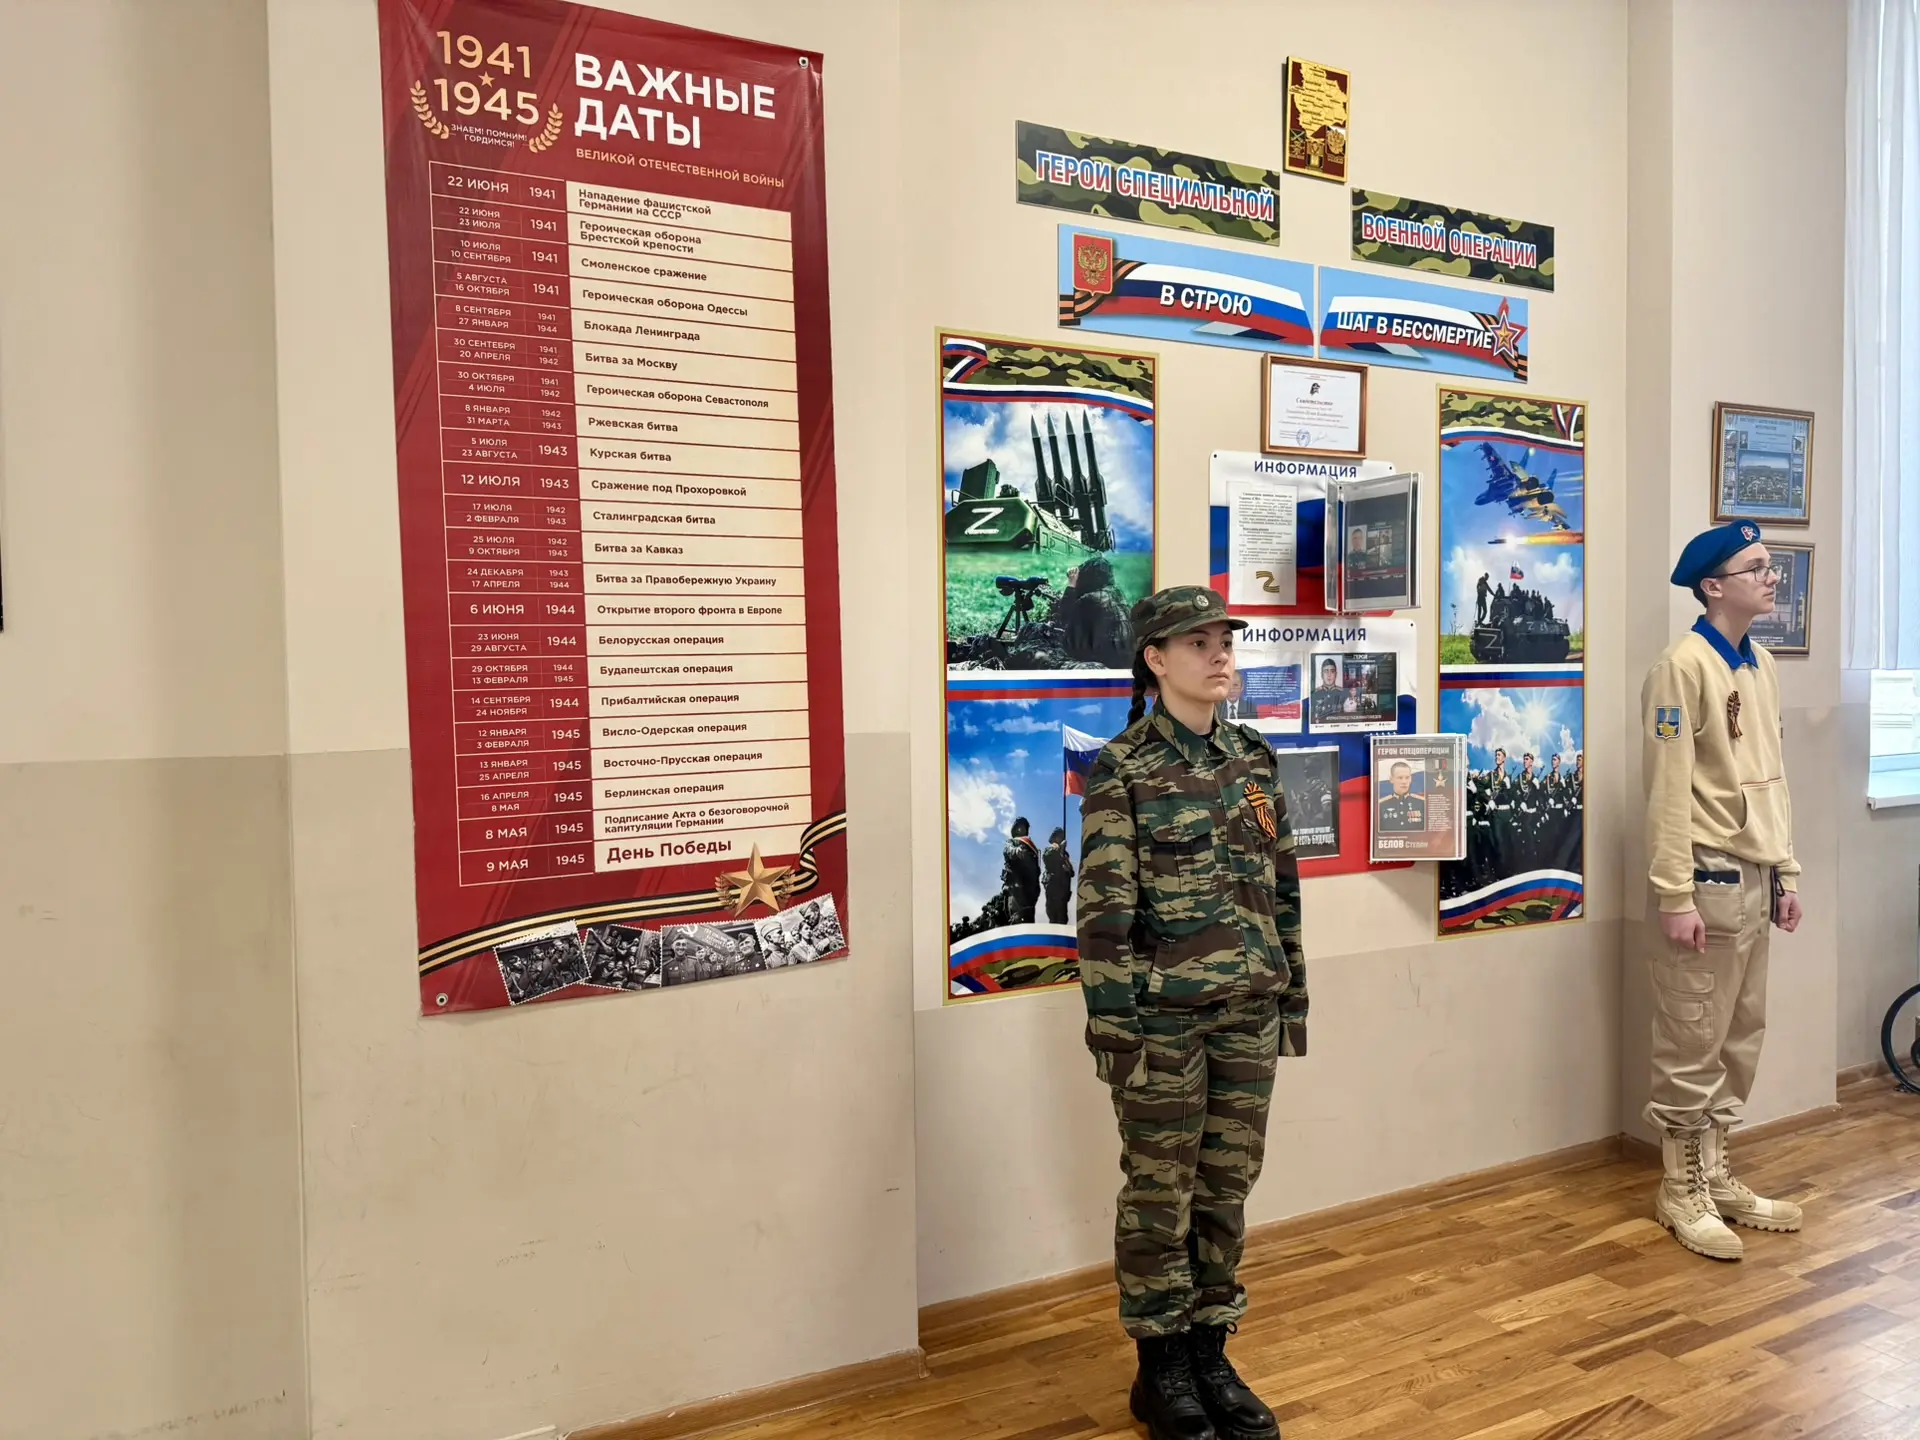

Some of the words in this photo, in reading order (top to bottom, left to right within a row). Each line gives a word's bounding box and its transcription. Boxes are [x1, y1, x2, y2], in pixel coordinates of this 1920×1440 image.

[436, 30, 532, 78] 1941
[575, 52, 775, 119] ВАЖНЫЕ
[433, 78, 540, 125] 1945
[574, 98, 701, 149] ДАТЫ
[451, 124, 484, 135] ЗНАЕМ!
[486, 129, 527, 141] ПОМНИМ!
[464, 134, 515, 148] ГОРДИМСЯ!
[576, 148, 635, 166] ВЕЛИКОЙ
[639, 154, 739, 182] ОТЕЧЕСТВЕННОЙ
[743, 172, 784, 188] ВОЙНЫ
[448, 176, 463, 189] 22
[468, 178, 509, 193] ИЮНЯ
[1035, 151, 1112, 193] ГЕРОИ
[1117, 166, 1275, 222] СПЕЦИАЛЬНОЙ
[529, 186, 556, 200] 1941
[579, 189, 640, 206] Нападение
[643, 198, 712, 216] фашистской
[459, 207, 470, 215] 22
[472, 208, 501, 218] ИЮНЯ
[579, 199, 633, 215] Германии
[636, 207, 649, 217] на
[652, 209, 682, 220] СССР
[459, 218, 470, 227] 23
[472, 220, 501, 230] ИЮЛЯ
[531, 219, 557, 232] 1941
[580, 221, 651, 238] Героическая
[654, 230, 702, 245] оборона
[580, 232, 640, 248] Брестской
[643, 240, 694, 254] крепости
[1362, 212, 1446, 252] ВОЕННОЙ
[1449, 231, 1537, 269] ОПЕРАЦИИ
[451, 250, 460, 259] 10
[463, 251, 512, 264] СЕНТЯБРЯ
[532, 251, 558, 264] 1941
[581, 258, 650, 274] Смоленское
[653, 267, 707, 283] сражение
[533, 283, 560, 296] 1941
[582, 289, 654, 306] Героическая
[657, 298, 704, 312] оборона
[707, 303, 748, 317] Одессы
[1160, 285, 1176, 306] В
[1180, 287, 1252, 318] СТРОЮ
[538, 313, 556, 321] 1941
[538, 325, 558, 333] 1944
[584, 321, 632, 335] Блокада
[636, 325, 700, 342] Ленинграда
[1337, 309, 1374, 332] ШАГ
[1377, 313, 1389, 334] В
[1392, 318, 1493, 350] БЕССМЕРТИЕ
[539, 345, 558, 354] 1941
[539, 357, 559, 366] 1942
[586, 352, 618, 365] Битва
[621, 357, 634, 366] за
[637, 358, 678, 372] Москву
[541, 377, 559, 386] 1941
[541, 389, 560, 398] 1942
[587, 385, 655, 400] Героическая
[658, 391, 702, 403] оборона
[705, 394, 769, 408] Севастополя
[542, 410, 561, 418] 1942
[542, 422, 562, 430] 1943
[588, 418, 644, 432] Ржевская
[647, 421, 678, 432] битва
[471, 437, 477, 446] 5
[479, 438, 508, 447] ИЮЛЯ
[462, 449, 473, 458] 23
[476, 450, 518, 460] АВГУСТА
[539, 445, 568, 457] 1943
[590, 448, 637, 463] Курская
[640, 452, 672, 463] битва
[1254, 461, 1357, 480] ИНФОРМАЦИЯ
[461, 475, 475, 485] 12
[479, 475, 521, 488] ИЮЛЯ
[540, 478, 569, 489] 1943
[591, 479, 649, 495] Сражение
[652, 484, 672, 495] под
[676, 483, 747, 498] Прохоровкой
[546, 506, 566, 514] 1942
[547, 518, 566, 526] 1943
[593, 511, 682, 526] Сталинградская
[686, 514, 716, 525] битва
[548, 538, 568, 546] 1942
[548, 550, 568, 558] 1943
[595, 544, 628, 554] Битва
[631, 546, 642, 554] за
[646, 544, 684, 555] Кавказ
[467, 568, 478, 576] 24
[481, 568, 524, 578] ДЕКАБРЯ
[549, 569, 569, 577] 1943
[472, 580, 481, 589] 17
[483, 580, 520, 589] АПРЕЛЯ
[550, 581, 570, 589] 1944
[596, 574, 628, 585] Битва
[632, 576, 643, 585] за
[646, 575, 733, 588] Правобережную
[736, 576, 777, 588] Украину
[470, 604, 478, 615] 6
[482, 604, 524, 615] ИЮНЯ
[546, 604, 576, 615] 1944
[598, 605, 651, 615] Открытие
[654, 606, 695, 617] второго
[698, 604, 736, 618] фронта
[739, 606, 744, 615] в
[747, 606, 782, 617] Европе
[548, 636, 576, 646] 1944
[599, 635, 670, 646] Белорусская
[673, 636, 724, 646] операция
[1242, 628, 1366, 644] ИНФОРМАЦИЯ
[553, 663, 573, 671] 1944
[600, 665, 679, 676] Будапештская
[682, 664, 733, 675] операция
[554, 675, 574, 683] 1945
[472, 697, 480, 705] 14
[484, 695, 531, 705] СЕНТЯБРЯ
[550, 697, 579, 708] 1944
[601, 694, 686, 706] Прибалтийская
[689, 693, 740, 705] операция
[552, 729, 580, 740] 1945
[602, 726, 694, 738] Висло-Одерская
[697, 723, 747, 734] операция
[553, 760, 582, 771] 1945
[603, 754, 710, 768] Восточно-Прусская
[713, 752, 763, 763] операция
[554, 792, 583, 802] 1945
[604, 785, 670, 799] Берлинская
[673, 784, 724, 796] операция
[604, 812, 669, 825] Подписание
[672, 810, 696, 820] Акта
[699, 810, 705, 818] о
[708, 804, 790, 818] безоговорочной
[555, 823, 584, 834] 1945
[604, 820, 673, 835] капитуляции
[676, 816, 724, 829] Германии
[485, 829, 494, 839] 8
[498, 827, 528, 839] МАЯ
[607, 846, 654, 864] День
[660, 838, 732, 858] Победы
[1378, 840, 1404, 849] БЕЛОВ
[486, 861, 495, 872] 9
[499, 859, 529, 871] МАЯ
[556, 854, 585, 865] 1945
